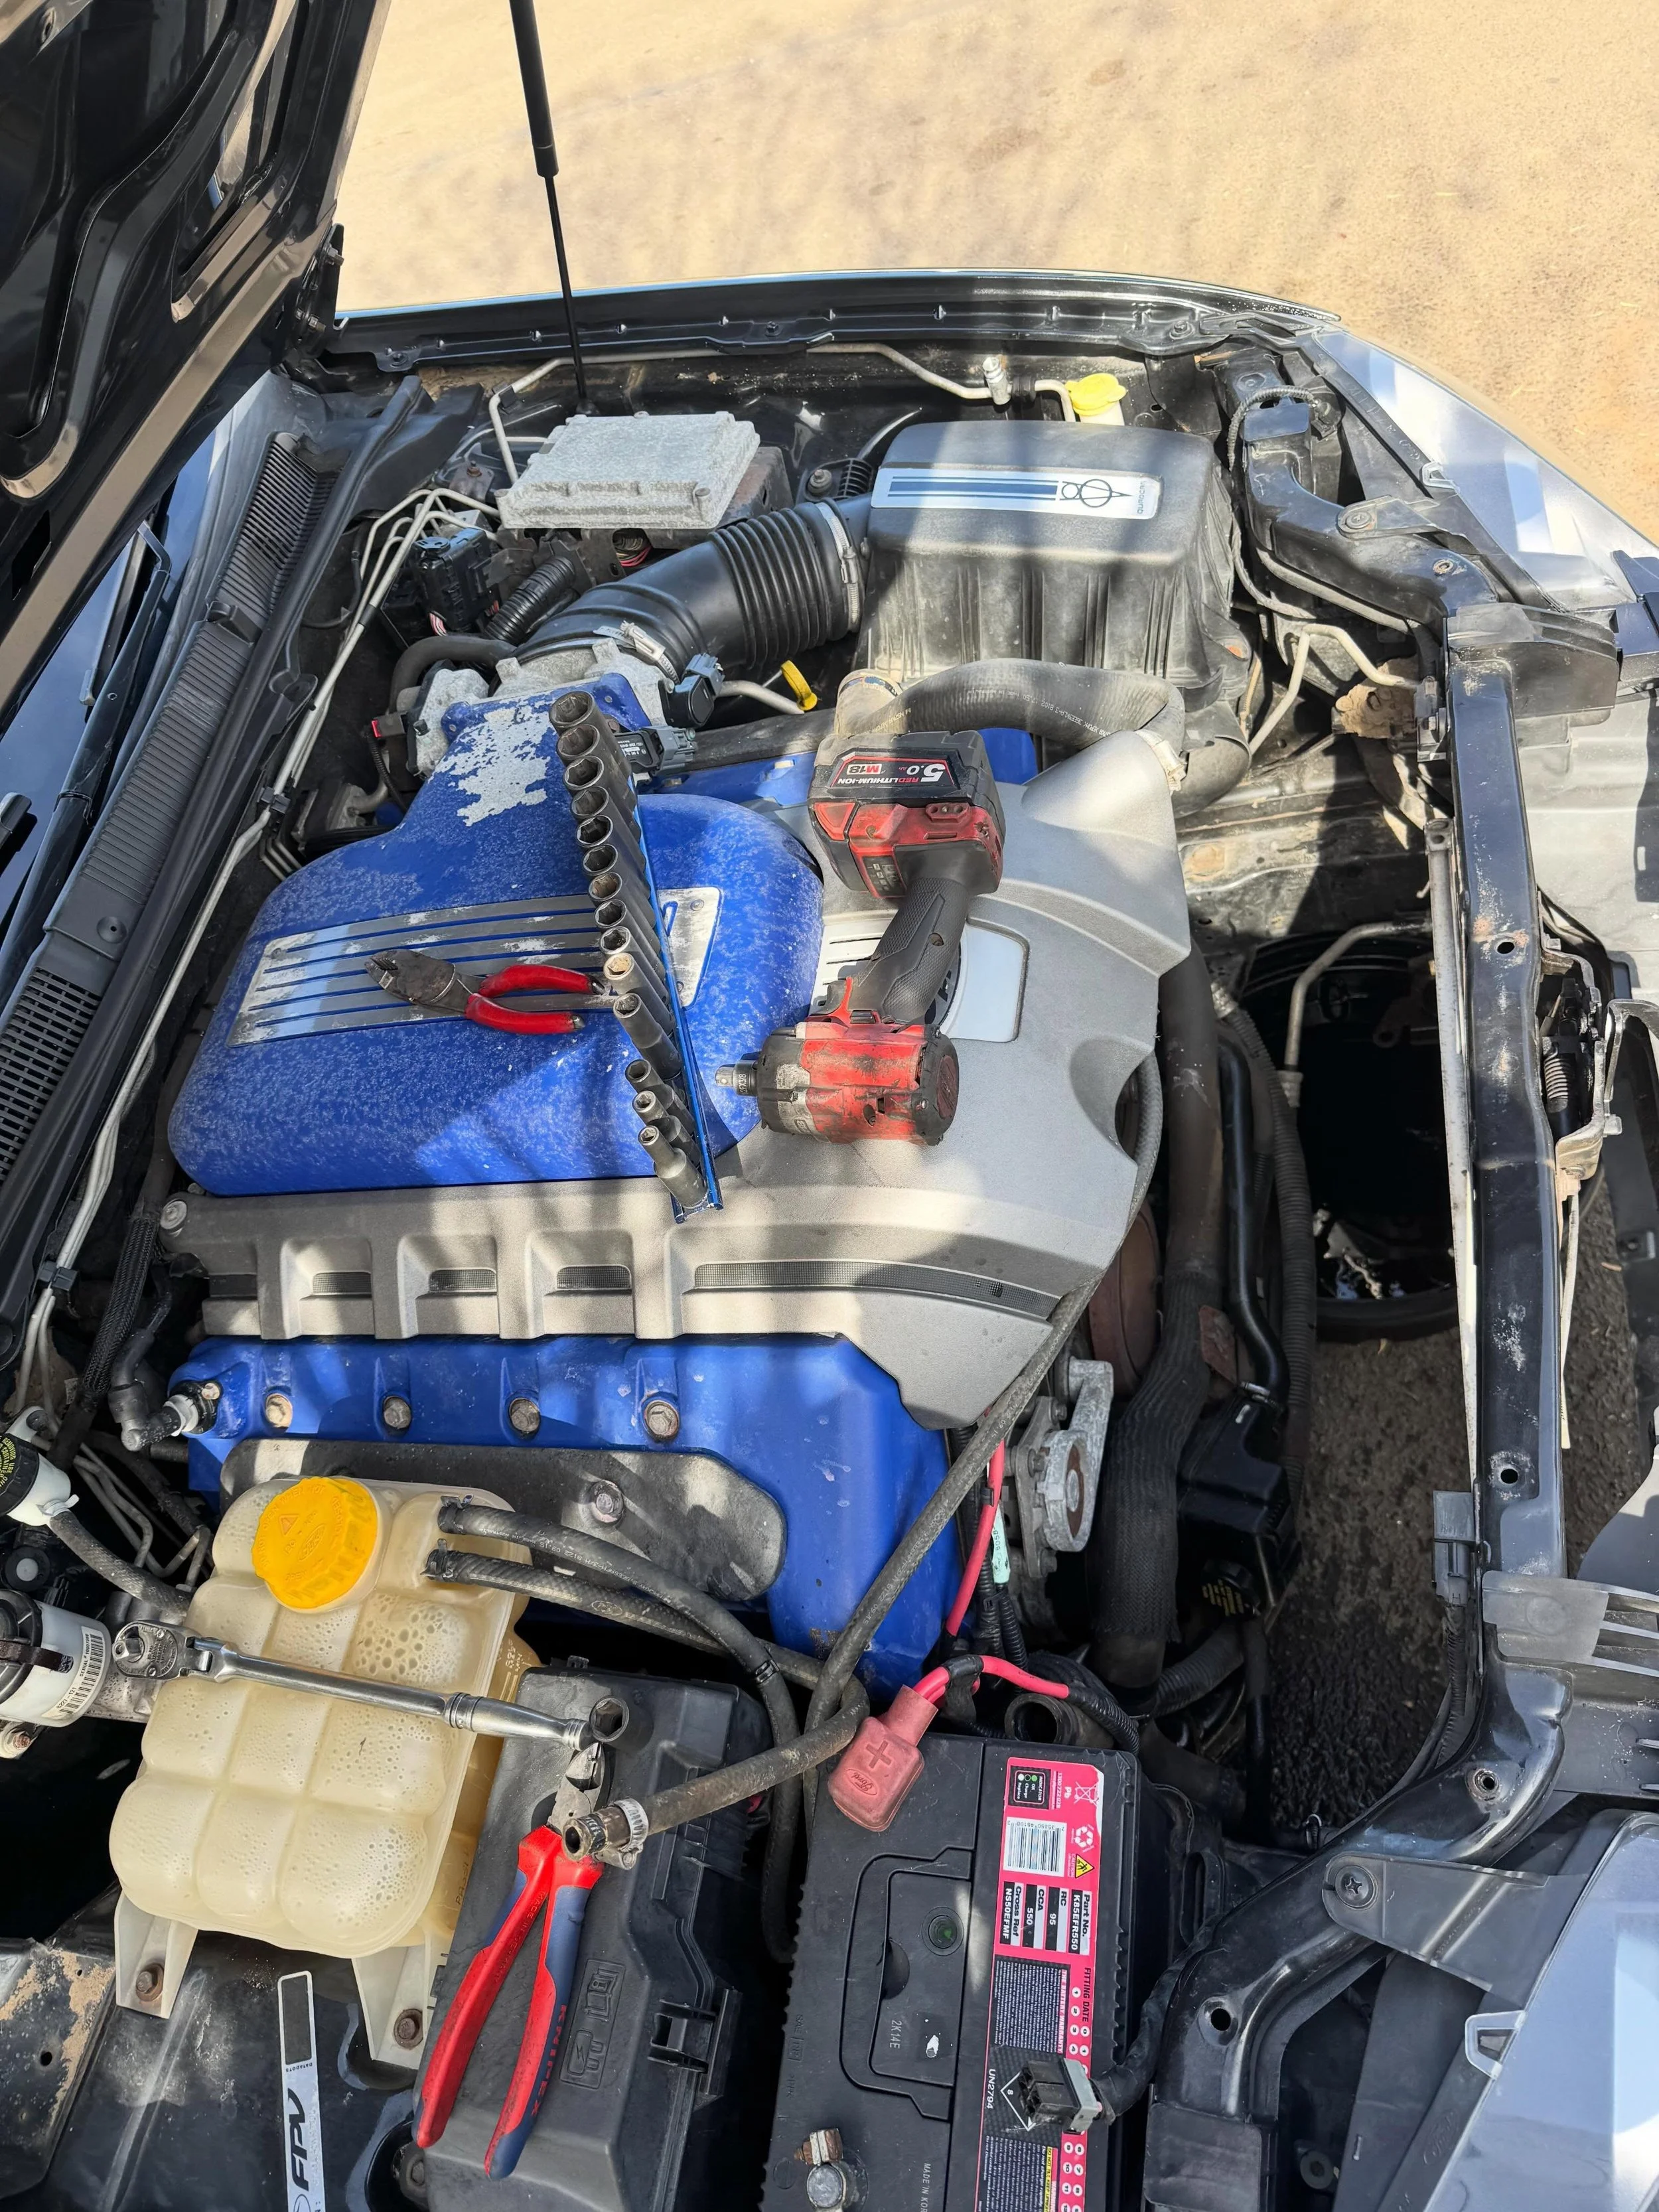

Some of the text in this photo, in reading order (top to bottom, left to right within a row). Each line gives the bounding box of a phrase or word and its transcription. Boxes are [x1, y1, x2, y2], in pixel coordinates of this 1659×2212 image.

[847, 764, 881, 774] M18
[1064, 1786, 1072, 1799] Pb
[526, 1890, 548, 1919] MADE
[1002, 1887, 1012, 1939] NS50EFMF
[1013, 1885, 1022, 1917] Cross
[1060, 1891, 1067, 1907] RC
[1048, 1913, 1056, 1925] 95
[1070, 1894, 1080, 1951] K85EFR550
[1082, 1967, 1092, 1999] FITTING
[1082, 2001, 1090, 2023] DATE
[889, 2020, 901, 2049] 2K14E
[285, 2062, 313, 2073] DATADOTS
[530, 2004, 567, 2116] KNIPEX
[985, 2068, 996, 2110] UN2794
[288, 2088, 309, 2191] FPV
[922, 2163, 931, 2184] MADE
[921, 2186, 929, 2195] IN
